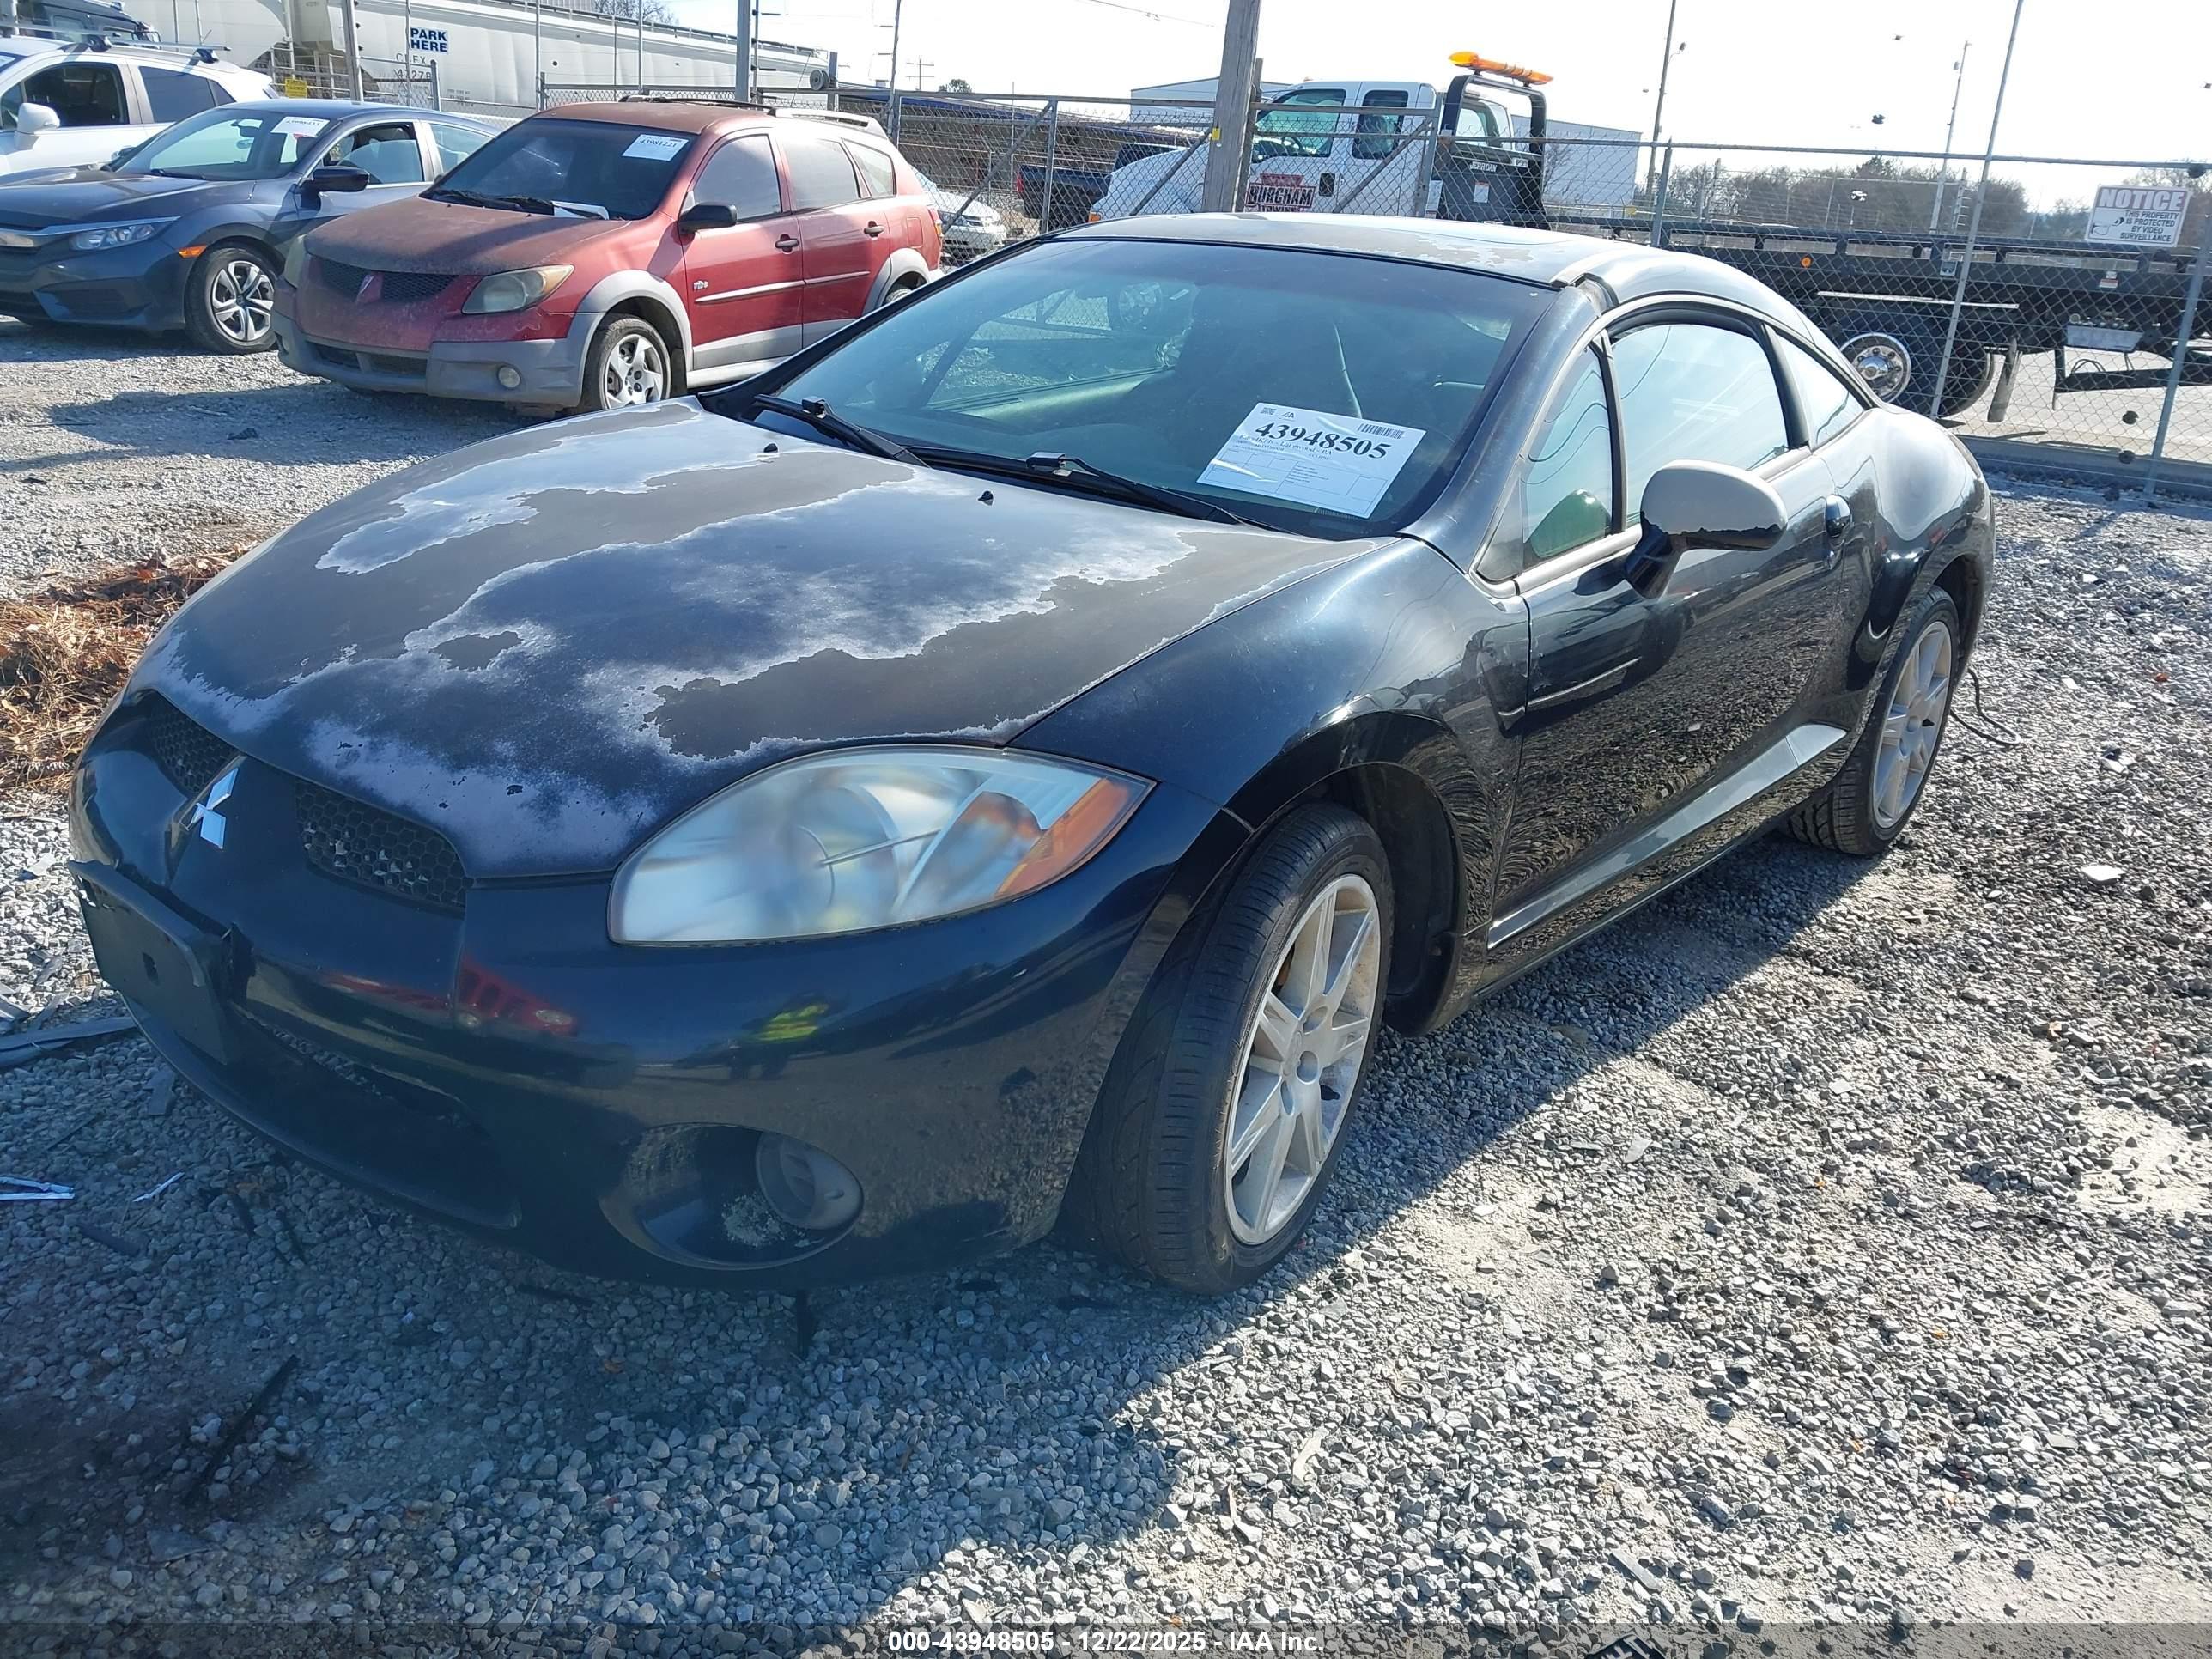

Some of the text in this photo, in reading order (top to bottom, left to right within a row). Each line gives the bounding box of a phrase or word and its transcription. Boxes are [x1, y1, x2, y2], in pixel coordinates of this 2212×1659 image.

[410, 27, 447, 41] PARK
[411, 40, 447, 52] HERE
[396, 53, 426, 65] CFX
[2099, 189, 2185, 210] NOTICE
[2142, 210, 2179, 219] PROPERTY
[2135, 218, 2175, 227] PROTECTED
[2119, 233, 2172, 241] SURVEILLANCE
[1255, 422, 1392, 460] 43948505
